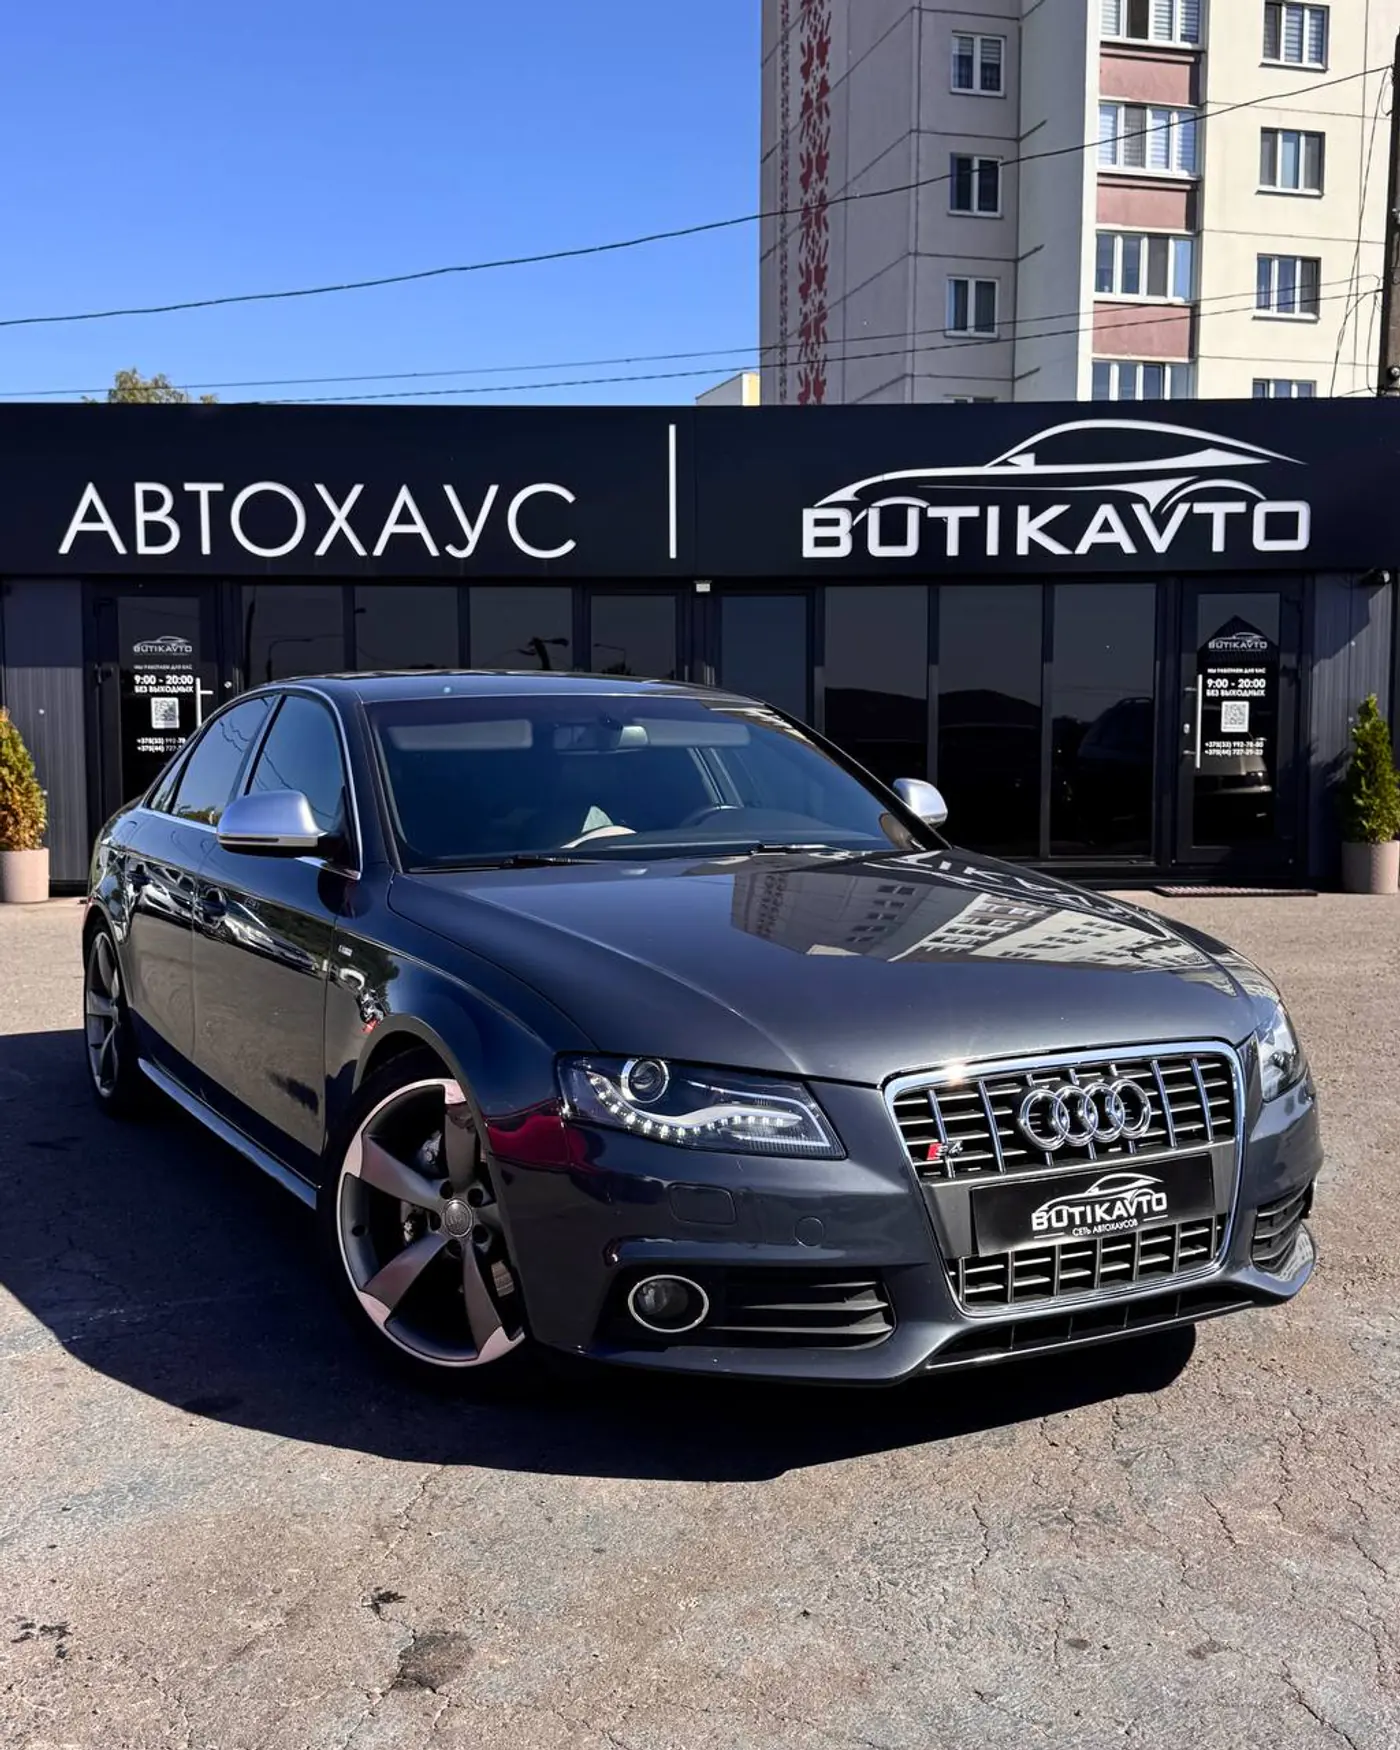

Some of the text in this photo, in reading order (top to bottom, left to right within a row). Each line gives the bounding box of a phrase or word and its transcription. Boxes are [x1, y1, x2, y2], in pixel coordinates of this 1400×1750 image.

[58, 481, 577, 559] АВТОХАУС
[801, 500, 1311, 559] BUTIKAVTO
[133, 644, 193, 653] BUTIKAVTO
[1208, 640, 1268, 649] BUTIKAVTO
[134, 674, 157, 685] 9:00
[165, 674, 194, 685] 20:00
[1206, 678, 1229, 689] 9:00
[1237, 678, 1266, 689] 20:00
[134, 685, 194, 694] БЕЗ ВЫХОДНЫХ
[1206, 689, 1266, 697] БЕЗ ВЫХОДНЫХ
[1031, 1191, 1168, 1232] BUTIKAVTO
[1072, 1218, 1139, 1237] СЕТЬ АВТОХАУСОВ
